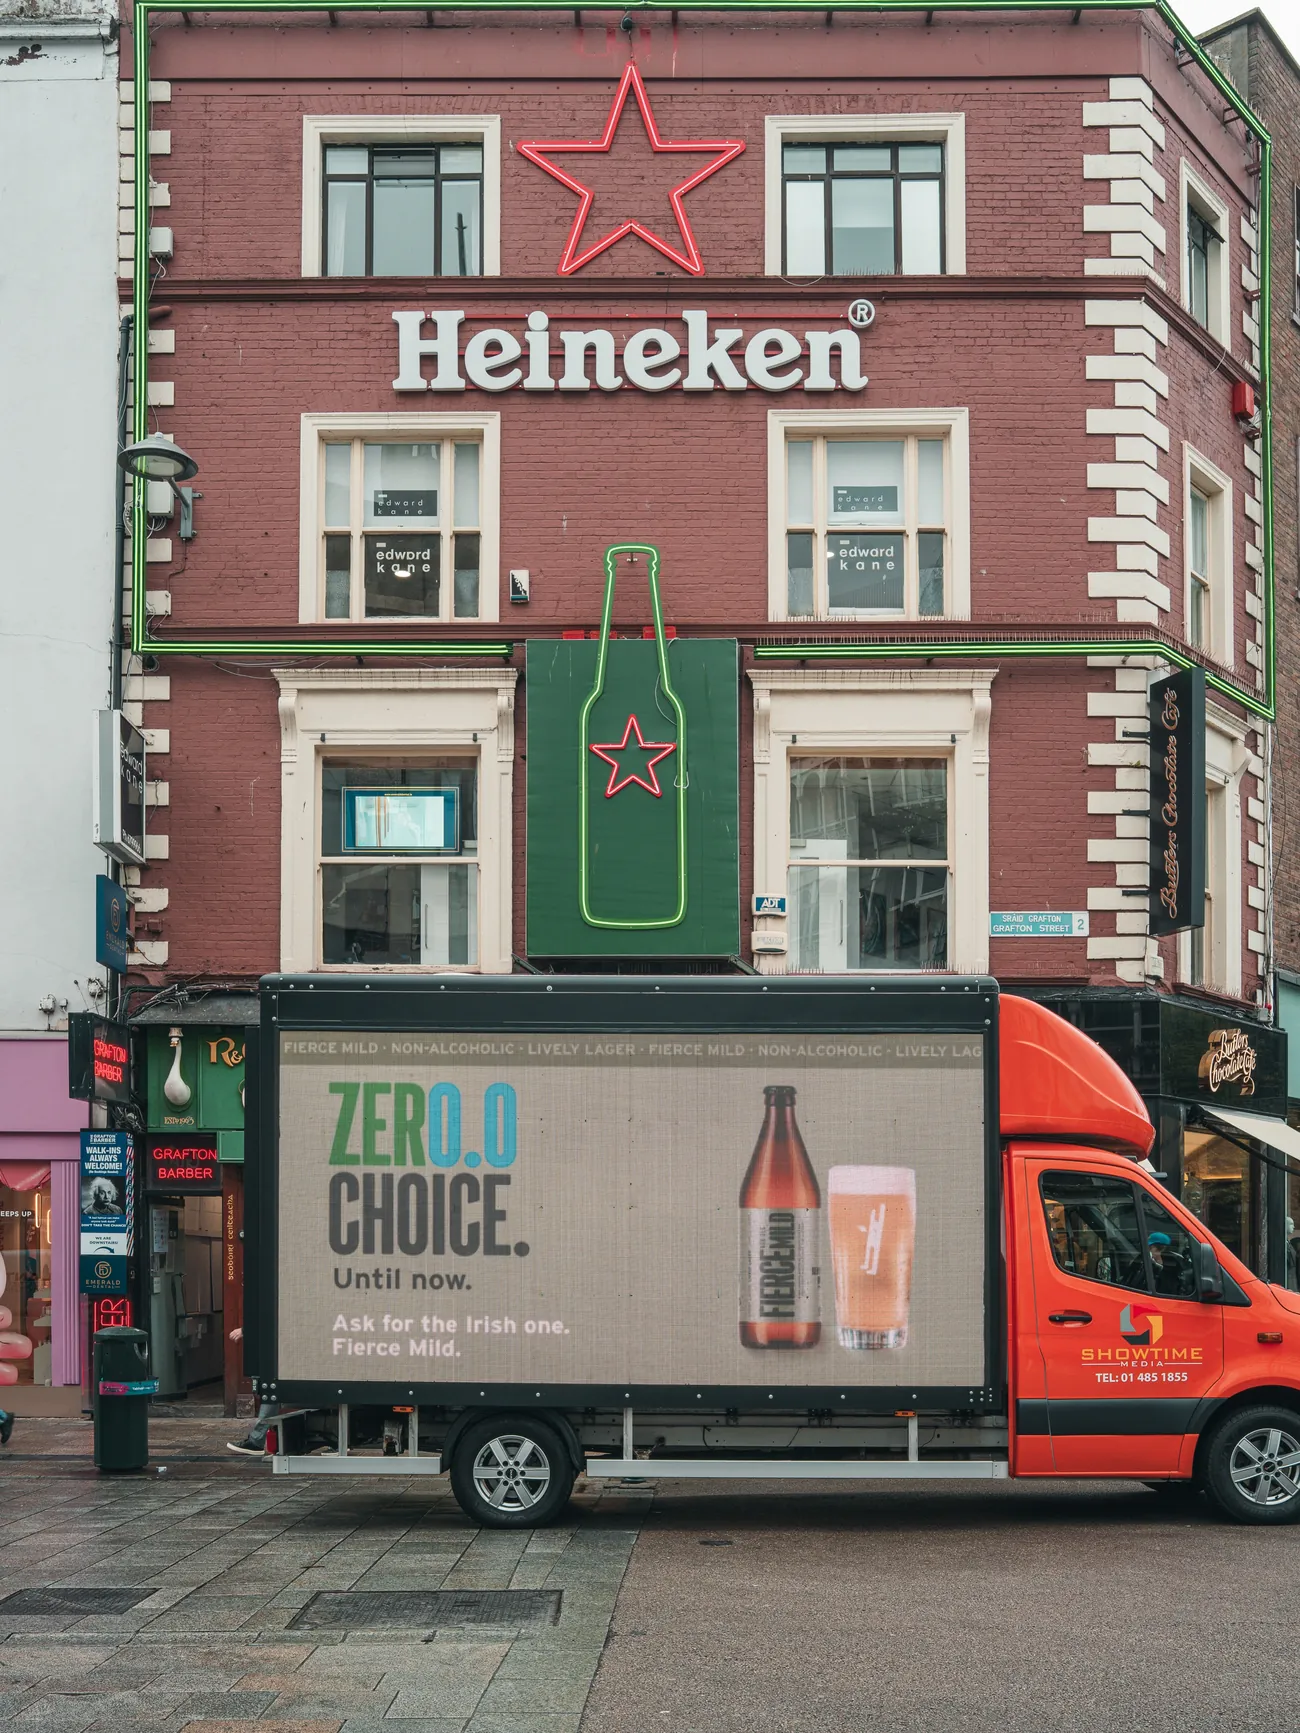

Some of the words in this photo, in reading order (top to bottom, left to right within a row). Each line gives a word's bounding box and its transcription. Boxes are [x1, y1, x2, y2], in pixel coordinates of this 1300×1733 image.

[392, 310, 869, 391] Heineken
[378, 499, 423, 507] edward
[837, 495, 883, 503] edward
[376, 549, 431, 560] edward
[839, 546, 894, 558] edward
[377, 562, 431, 573] kane
[840, 559, 895, 571] kane
[1161, 735, 1178, 827] Chocolate
[1159, 830, 1180, 919] Butlers
[761, 898, 781, 908] ADT
[1002, 914, 1024, 922] SRÁID
[993, 924, 1033, 932] GRAFTON
[1039, 924, 1070, 932] STREET
[1077, 919, 1085, 930] 2
[94, 1039, 127, 1063] GRAFTON
[284, 1042, 337, 1054] FIERCE
[342, 1042, 379, 1054] MILD
[391, 1042, 515, 1055] NON-ALCOHOLIC
[528, 1043, 580, 1055] LIVELY
[585, 1043, 635, 1056] LAGER
[649, 1044, 703, 1056] FIERCE
[708, 1044, 745, 1056] MILD
[758, 1044, 883, 1057] NON-ALCOHOLIC
[896, 1045, 947, 1057] LIVELY
[1216, 1029, 1249, 1062] Butlers
[94, 1060, 123, 1083] BARBER
[1210, 1052, 1243, 1092] Chocolate
[85, 1146, 122, 1154] WALK-INS
[152, 1147, 218, 1160] GRAFTON
[89, 1154, 118, 1162] ALWAYS
[84, 1162, 123, 1170] WELCOME!
[158, 1167, 213, 1179] BARBER
[328, 1172, 530, 1257] CHOICE.
[768, 1212, 796, 1249] MILD
[334, 1268, 400, 1289] Until
[412, 1273, 472, 1290] now.
[759, 1248, 796, 1318] FIERCE
[332, 1314, 374, 1333] Ask
[382, 1314, 414, 1333] for
[421, 1315, 457, 1333] the
[466, 1315, 516, 1334] Irish
[524, 1319, 570, 1335] one.
[332, 1338, 400, 1356] Fierce
[409, 1338, 461, 1357] Mild.
[1081, 1348, 1203, 1360] SHOWTIME
[1095, 1373, 1119, 1383] TEL:
[1121, 1373, 1134, 1383] 01
[1137, 1373, 1158, 1382] 485
[1161, 1372, 1188, 1382] 1855
